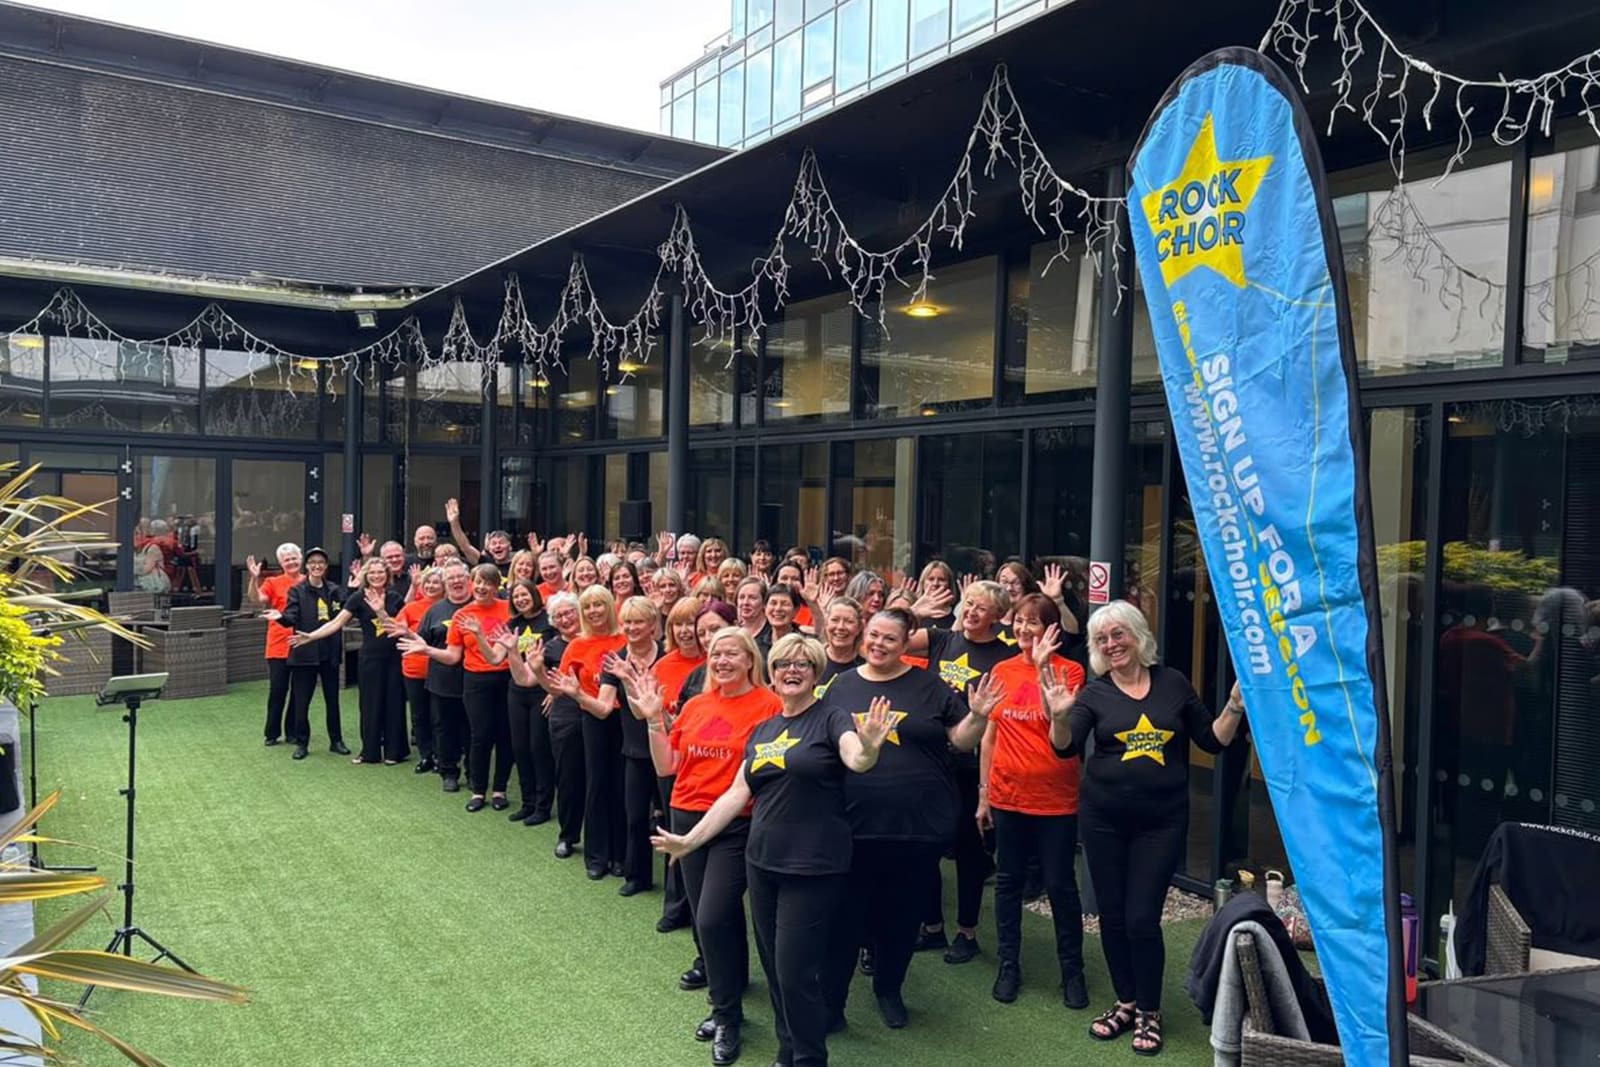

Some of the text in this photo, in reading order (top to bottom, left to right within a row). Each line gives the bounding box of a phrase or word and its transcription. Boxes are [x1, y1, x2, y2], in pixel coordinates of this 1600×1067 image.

[1158, 168, 1242, 224] ROCK
[1154, 211, 1246, 263] CHOIR
[1183, 382, 1272, 675] www.rockchoir.com
[1202, 353, 1317, 658] SIGN UP FOR A
[1126, 742, 1163, 752] CHOIR
[1127, 732, 1164, 743] ROCK
